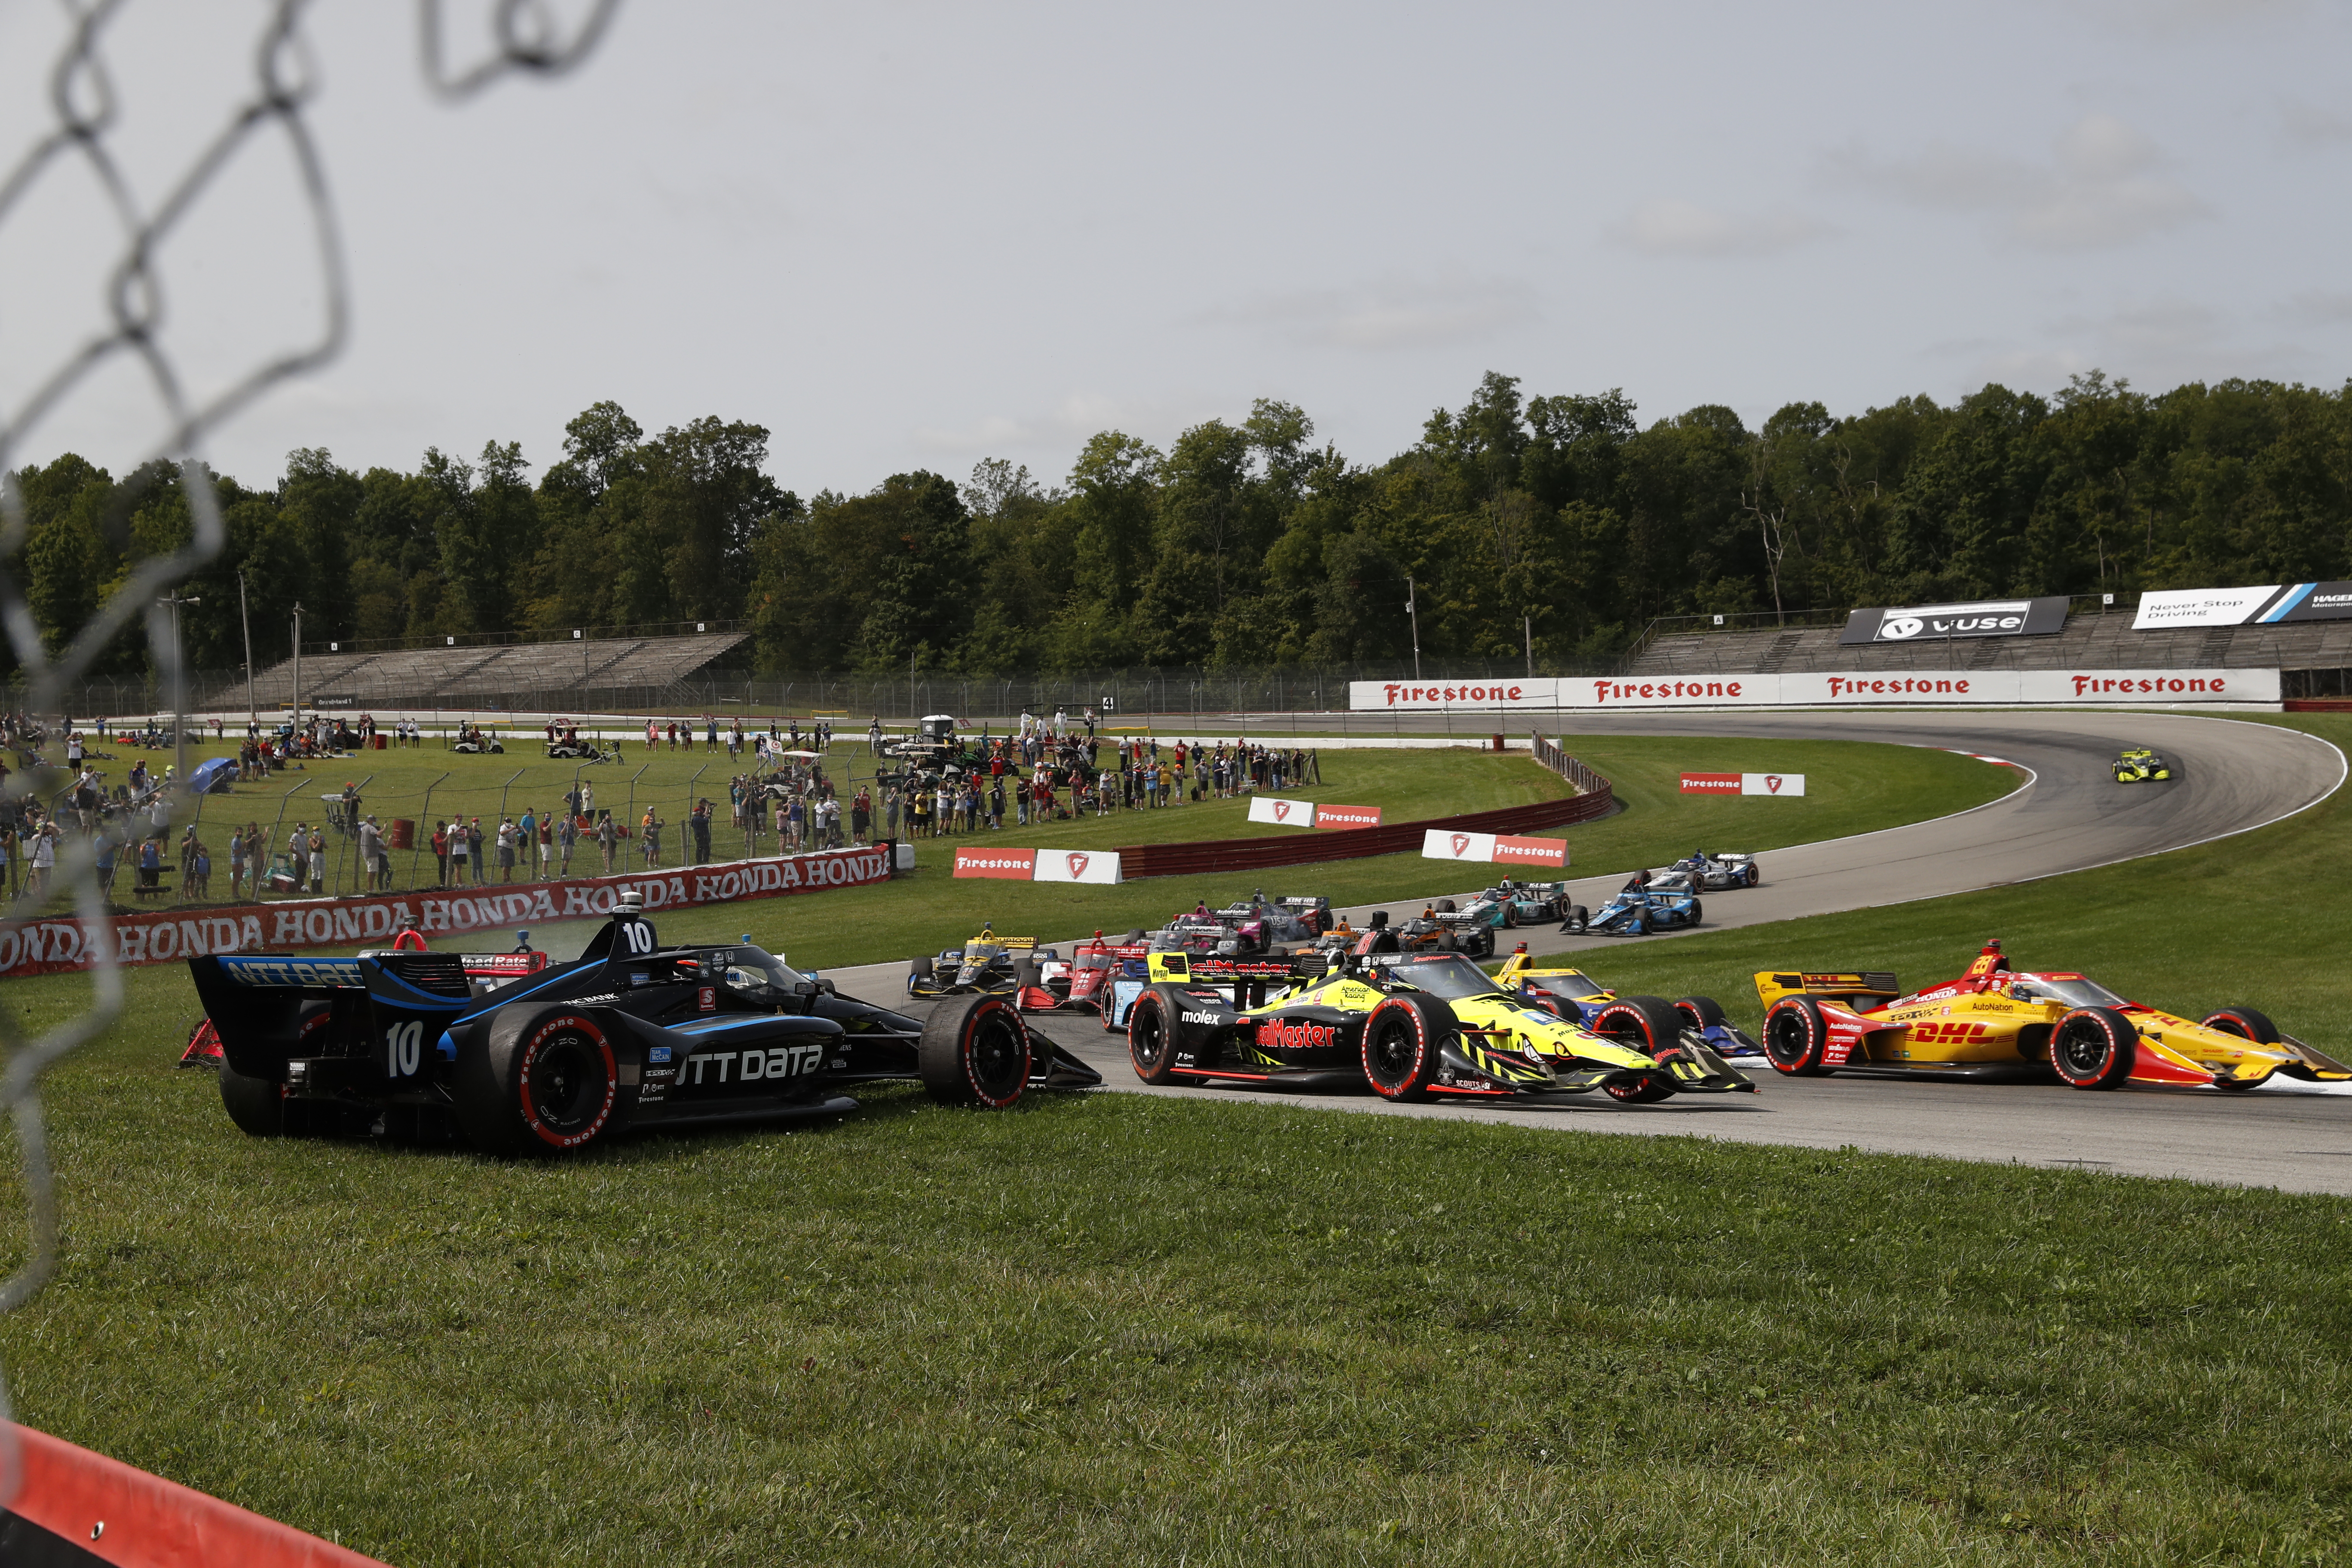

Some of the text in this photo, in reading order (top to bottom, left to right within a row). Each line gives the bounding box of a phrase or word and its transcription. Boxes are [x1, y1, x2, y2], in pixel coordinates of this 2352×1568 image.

[2150, 602, 2198, 611] Never
[2148, 610, 2208, 619] Driving
[1932, 616, 2021, 632] vuse
[1593, 680, 1742, 703] Firestone
[1827, 677, 1970, 698] Firestone
[2071, 675, 2226, 698] Firestone
[1384, 684, 1522, 706] Firestone
[1104, 698, 1112, 709] 4
[1681, 779, 1740, 788] Firestone
[995, 791, 999, 799] 8
[1318, 812, 1378, 824] Firestone
[1495, 844, 1563, 858] Firestone
[957, 857, 1031, 870] Firestone
[116, 916, 263, 963] HONDA
[270, 902, 413, 944] HONDA
[421, 889, 559, 931] HONDA
[692, 862, 801, 901] HONDA
[805, 850, 889, 885] HONDA
[622, 922, 652, 953] 10
[1354, 931, 1377, 955] 18
[495, 956, 527, 967] Rate
[1189, 960, 1291, 974] alMaster
[1971, 955, 1994, 974] 28
[228, 962, 291, 985] NTT
[1152, 968, 1168, 978] Morgan
[1345, 992, 1365, 1002] Racing
[1903, 993, 1919, 1003] EDGE
[1915, 989, 1957, 1002] HONDA
[1972, 1003, 2013, 1011] AutoNation
[1182, 1009, 1221, 1025] molex
[1602, 1006, 1645, 1024] Firestone
[1890, 1012, 1912, 1021] HPD
[1914, 1022, 1997, 1044] DHL
[386, 1020, 423, 1078] 10
[1456, 1079, 1480, 1087] SCOUTS
